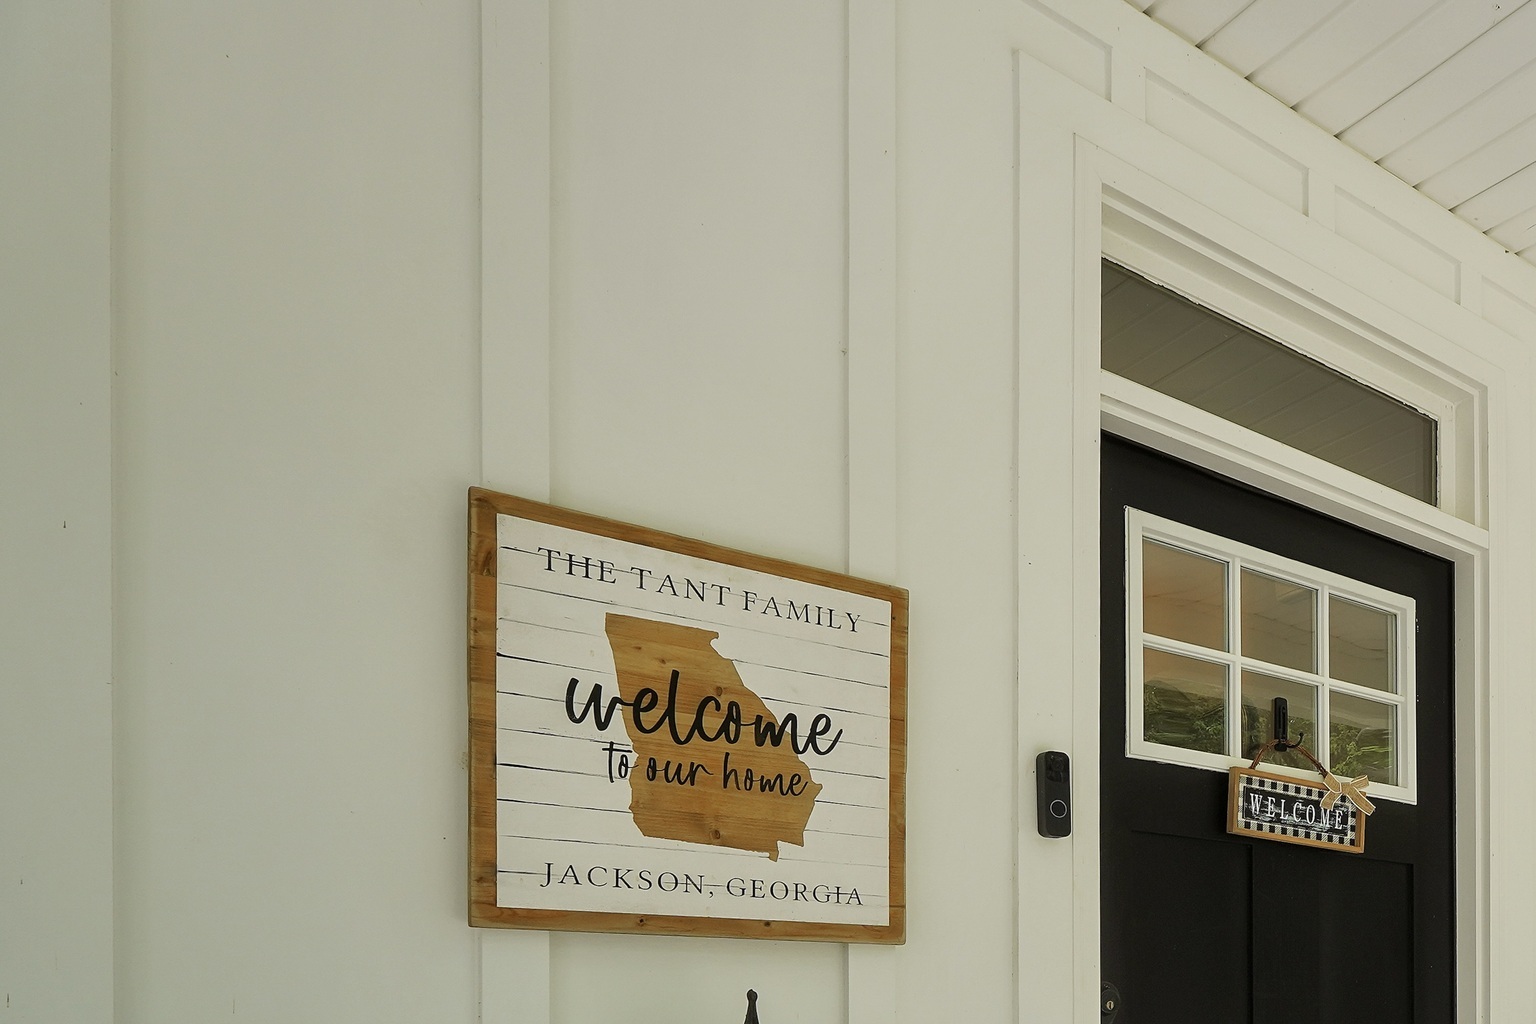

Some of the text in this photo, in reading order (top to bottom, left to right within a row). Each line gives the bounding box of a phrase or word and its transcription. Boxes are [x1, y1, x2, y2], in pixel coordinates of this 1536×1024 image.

[537, 547, 861, 633] THE TANT FAMILY
[565, 670, 843, 755] welcome
[602, 741, 807, 796] to our home
[1250, 793, 1343, 830] WELCOME
[540, 862, 863, 906] JACKSON, GEORGIA
